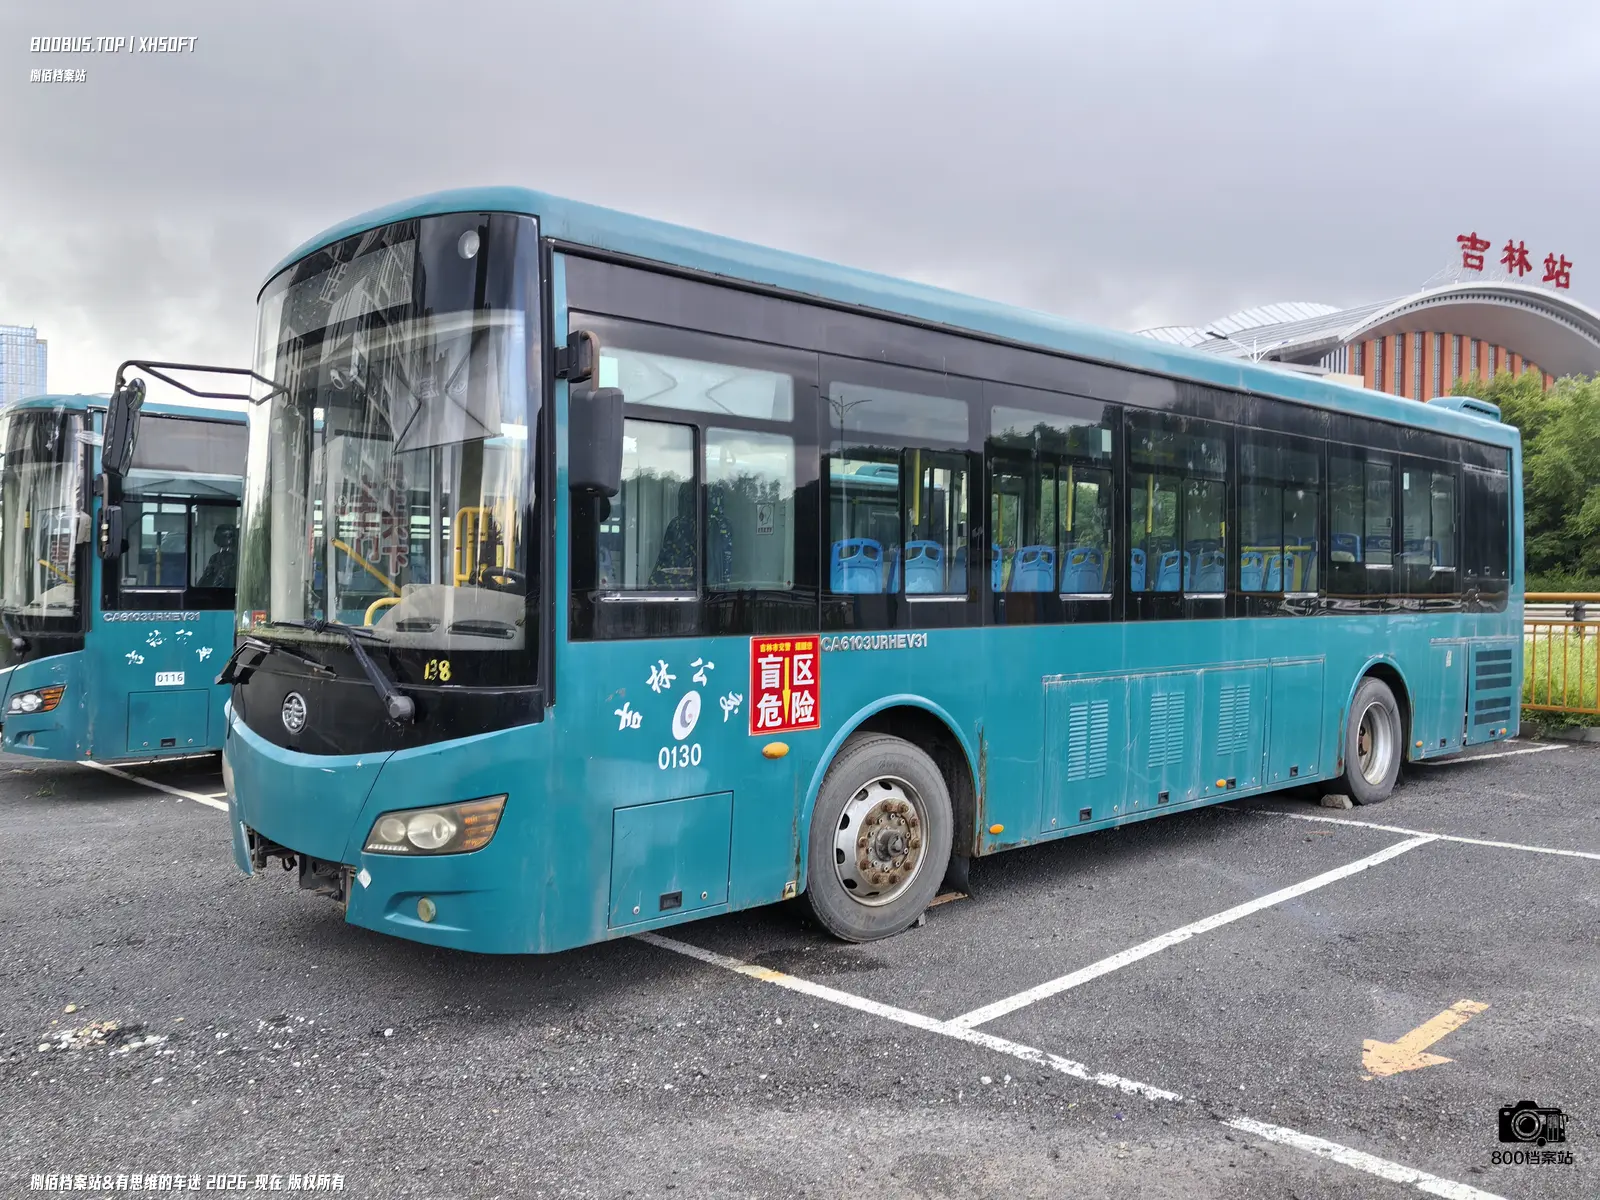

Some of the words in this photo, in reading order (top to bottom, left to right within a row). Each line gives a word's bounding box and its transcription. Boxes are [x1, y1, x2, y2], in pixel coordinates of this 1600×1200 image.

[1456, 231, 1573, 290] 吉林站
[821, 632, 928, 652] CA6103URHEV31
[157, 673, 184, 683] 0116
[757, 653, 815, 690] 盲区
[756, 690, 816, 729] 危险
[658, 742, 702, 770] 0130
